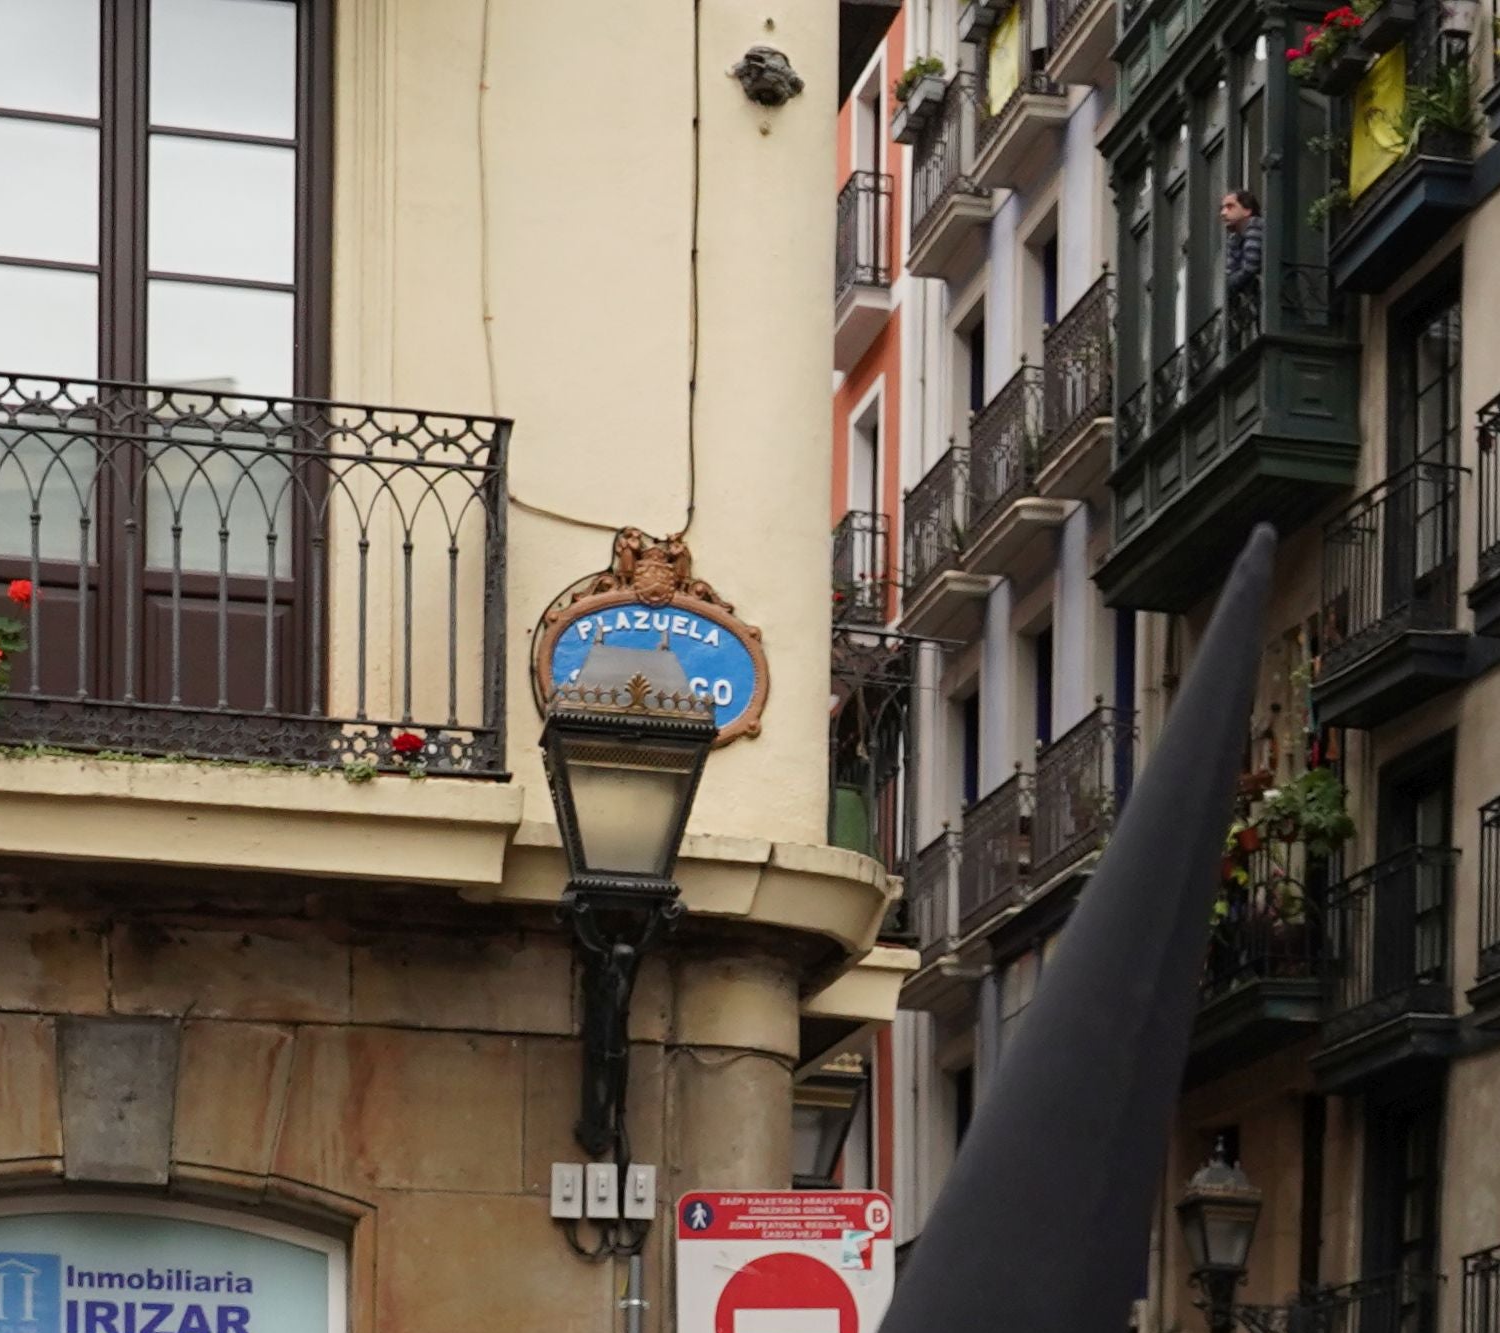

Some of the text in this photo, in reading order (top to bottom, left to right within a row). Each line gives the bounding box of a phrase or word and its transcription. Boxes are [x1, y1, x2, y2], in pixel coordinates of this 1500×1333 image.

[576, 610, 720, 647] PLAZUELA
[872, 1208, 885, 1224] B
[729, 1222, 754, 1230] ZONA
[755, 1222, 803, 1230] PEATONAL
[762, 1230, 794, 1238] CASCO
[67, 1265, 254, 1294] Inmobiliaria
